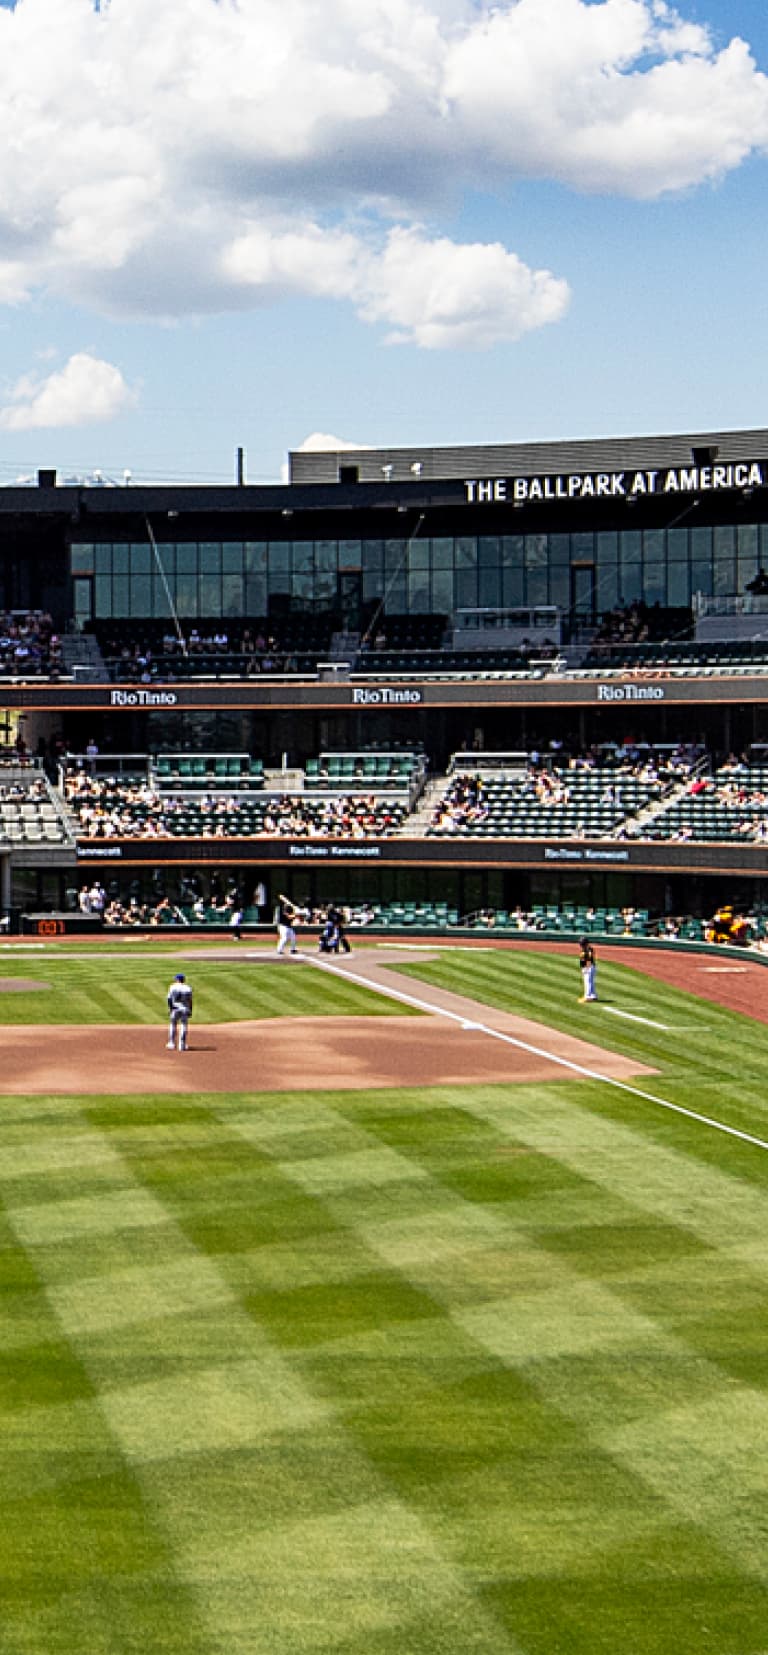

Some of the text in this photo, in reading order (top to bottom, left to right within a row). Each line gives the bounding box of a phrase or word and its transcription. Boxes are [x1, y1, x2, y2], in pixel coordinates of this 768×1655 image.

[464, 463, 762, 501] THE BALLPARK AT AMERICA
